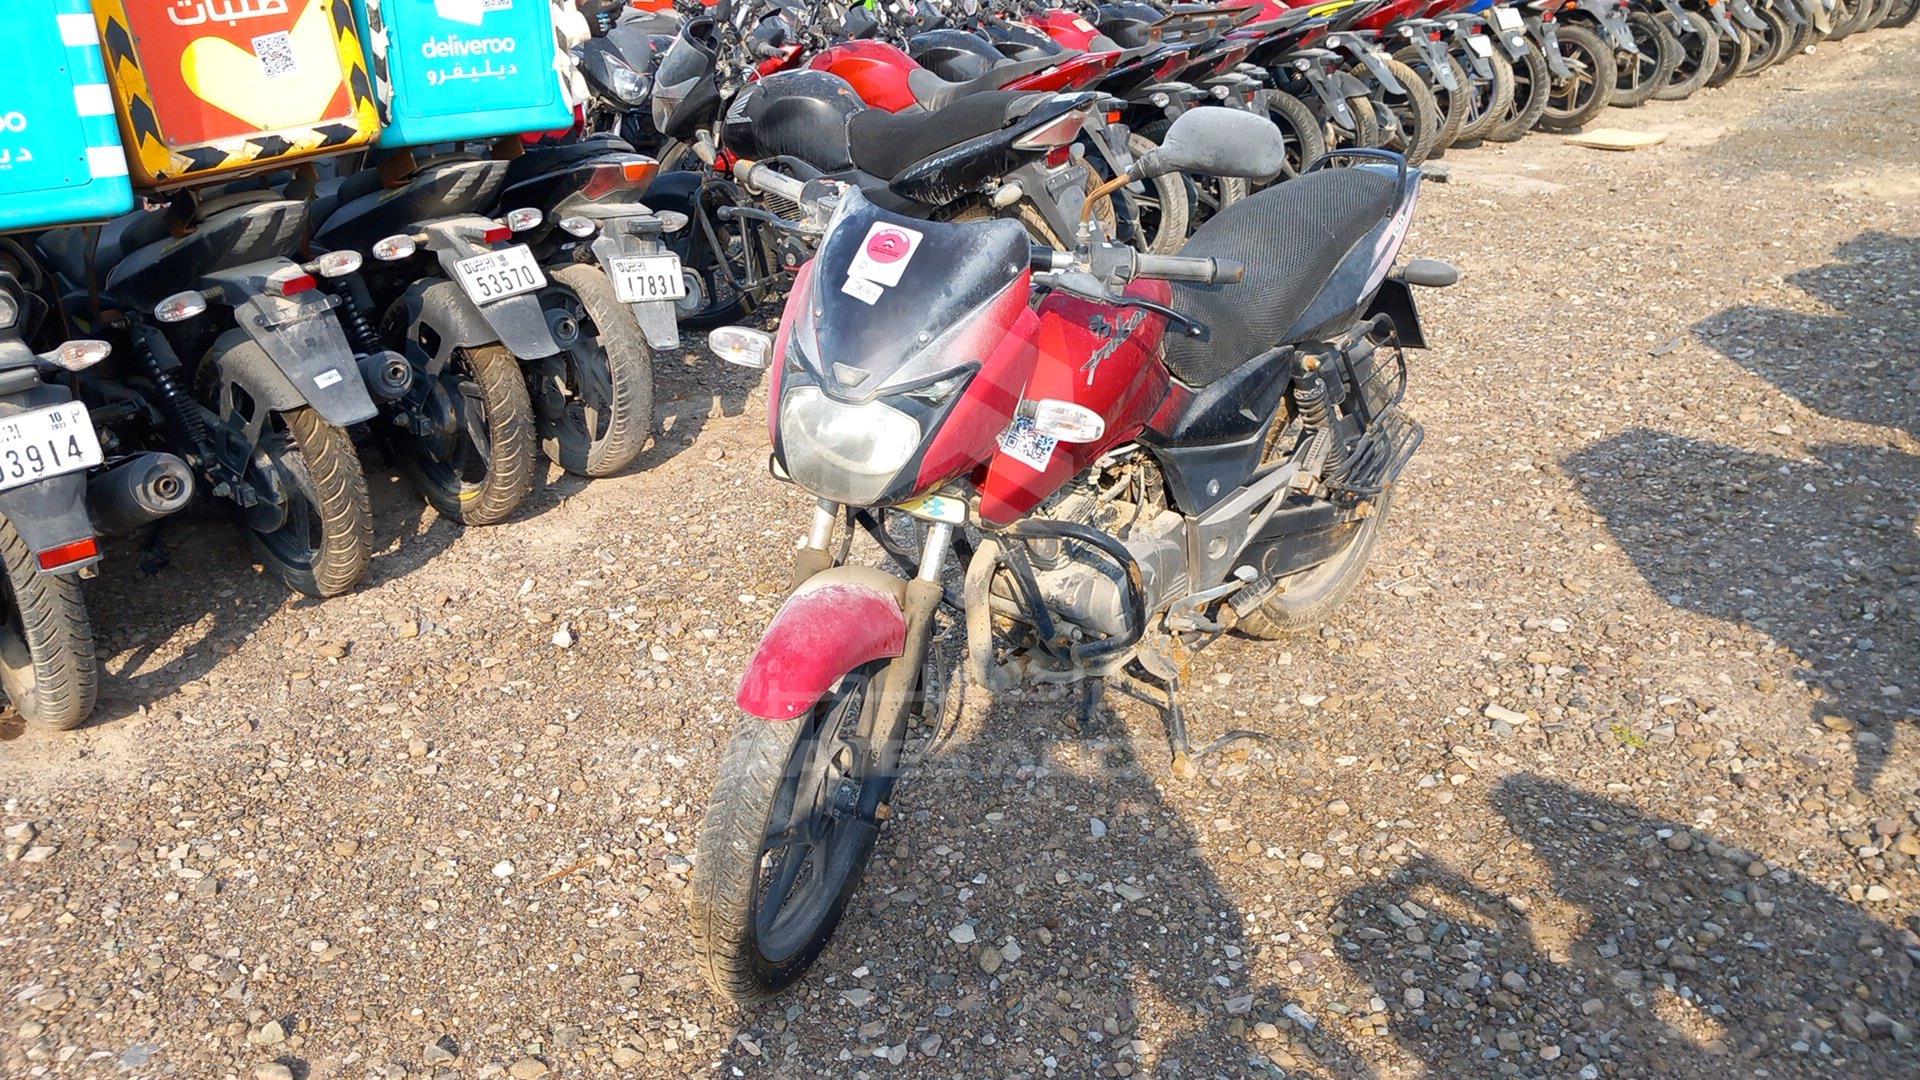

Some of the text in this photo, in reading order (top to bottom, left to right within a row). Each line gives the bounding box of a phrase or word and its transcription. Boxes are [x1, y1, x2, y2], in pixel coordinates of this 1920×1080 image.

[422, 34, 516, 59] deliveroo
[426, 59, 518, 86] ديليفرو
[476, 265, 536, 297] 53570
[628, 274, 676, 296] 17831
[48, 411, 63, 423] 10
[0, 434, 83, 483] 3914
